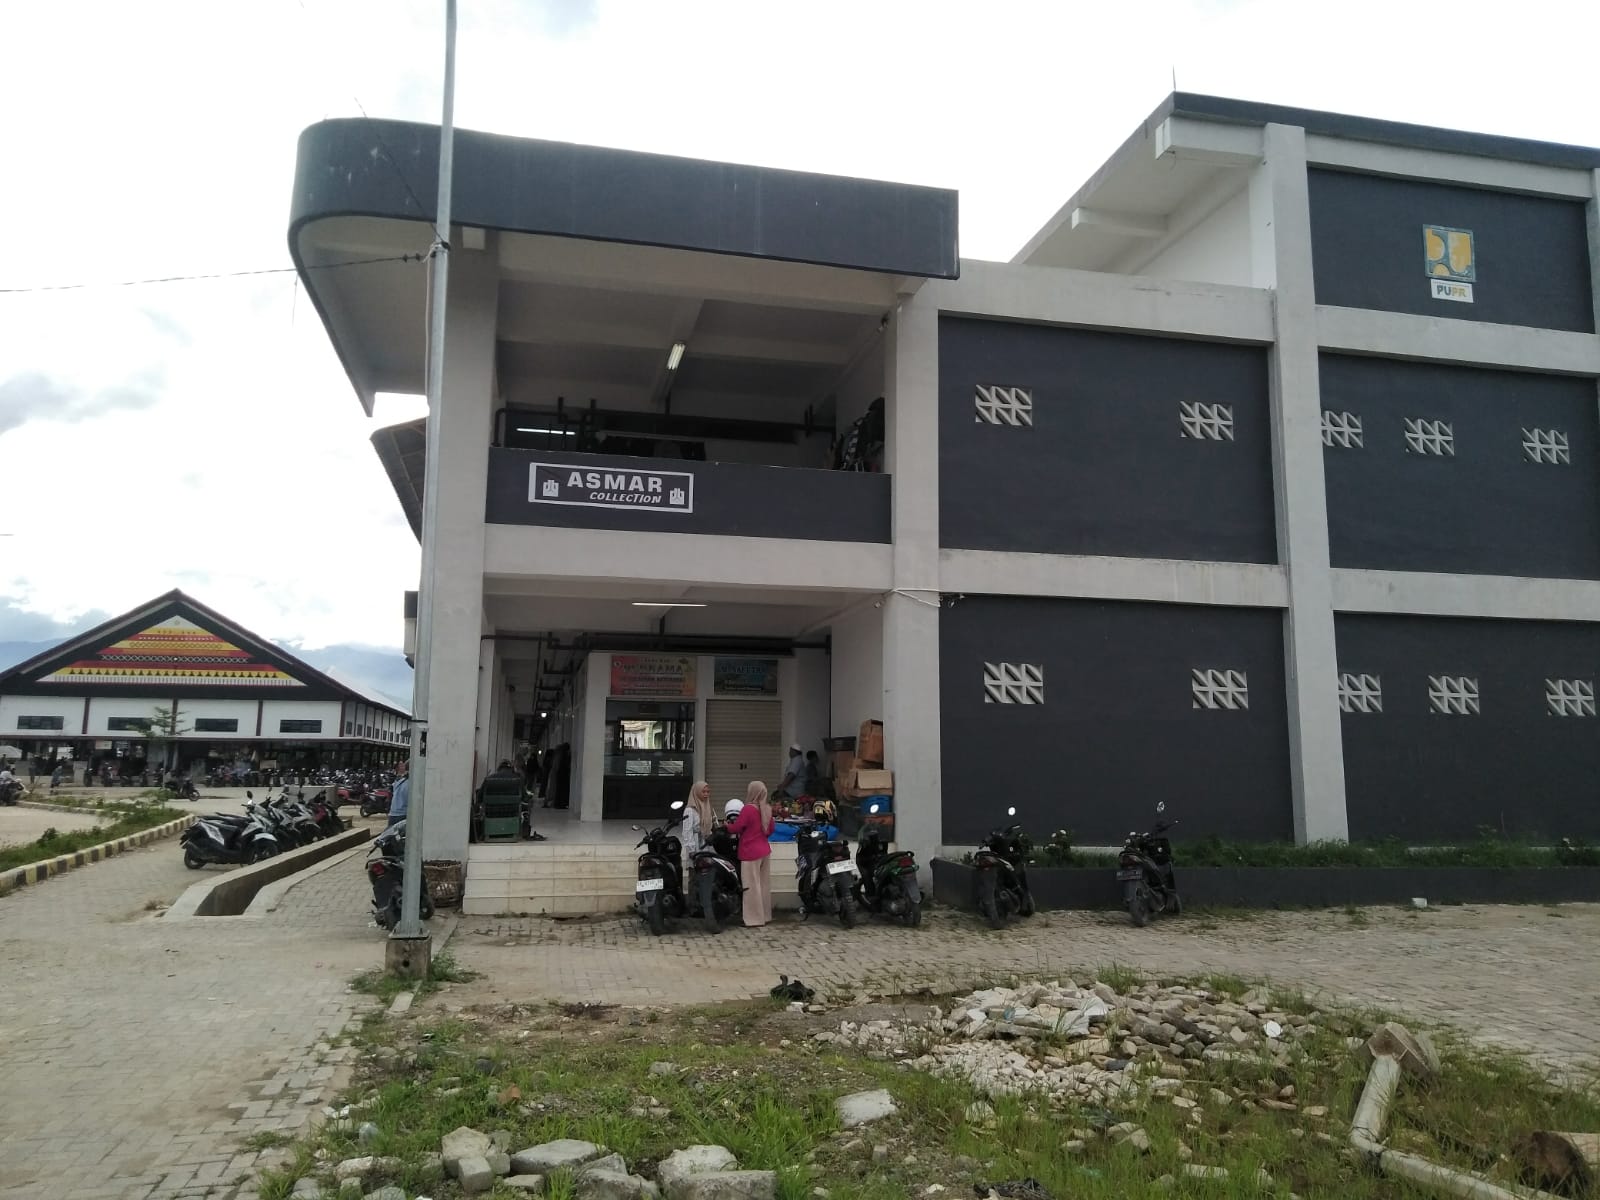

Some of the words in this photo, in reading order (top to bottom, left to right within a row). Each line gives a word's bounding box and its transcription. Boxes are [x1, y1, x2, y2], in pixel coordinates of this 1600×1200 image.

[1437, 284, 1467, 298] PUPR
[567, 471, 663, 493] ASMAR
[589, 491, 662, 504] COLLECTION
